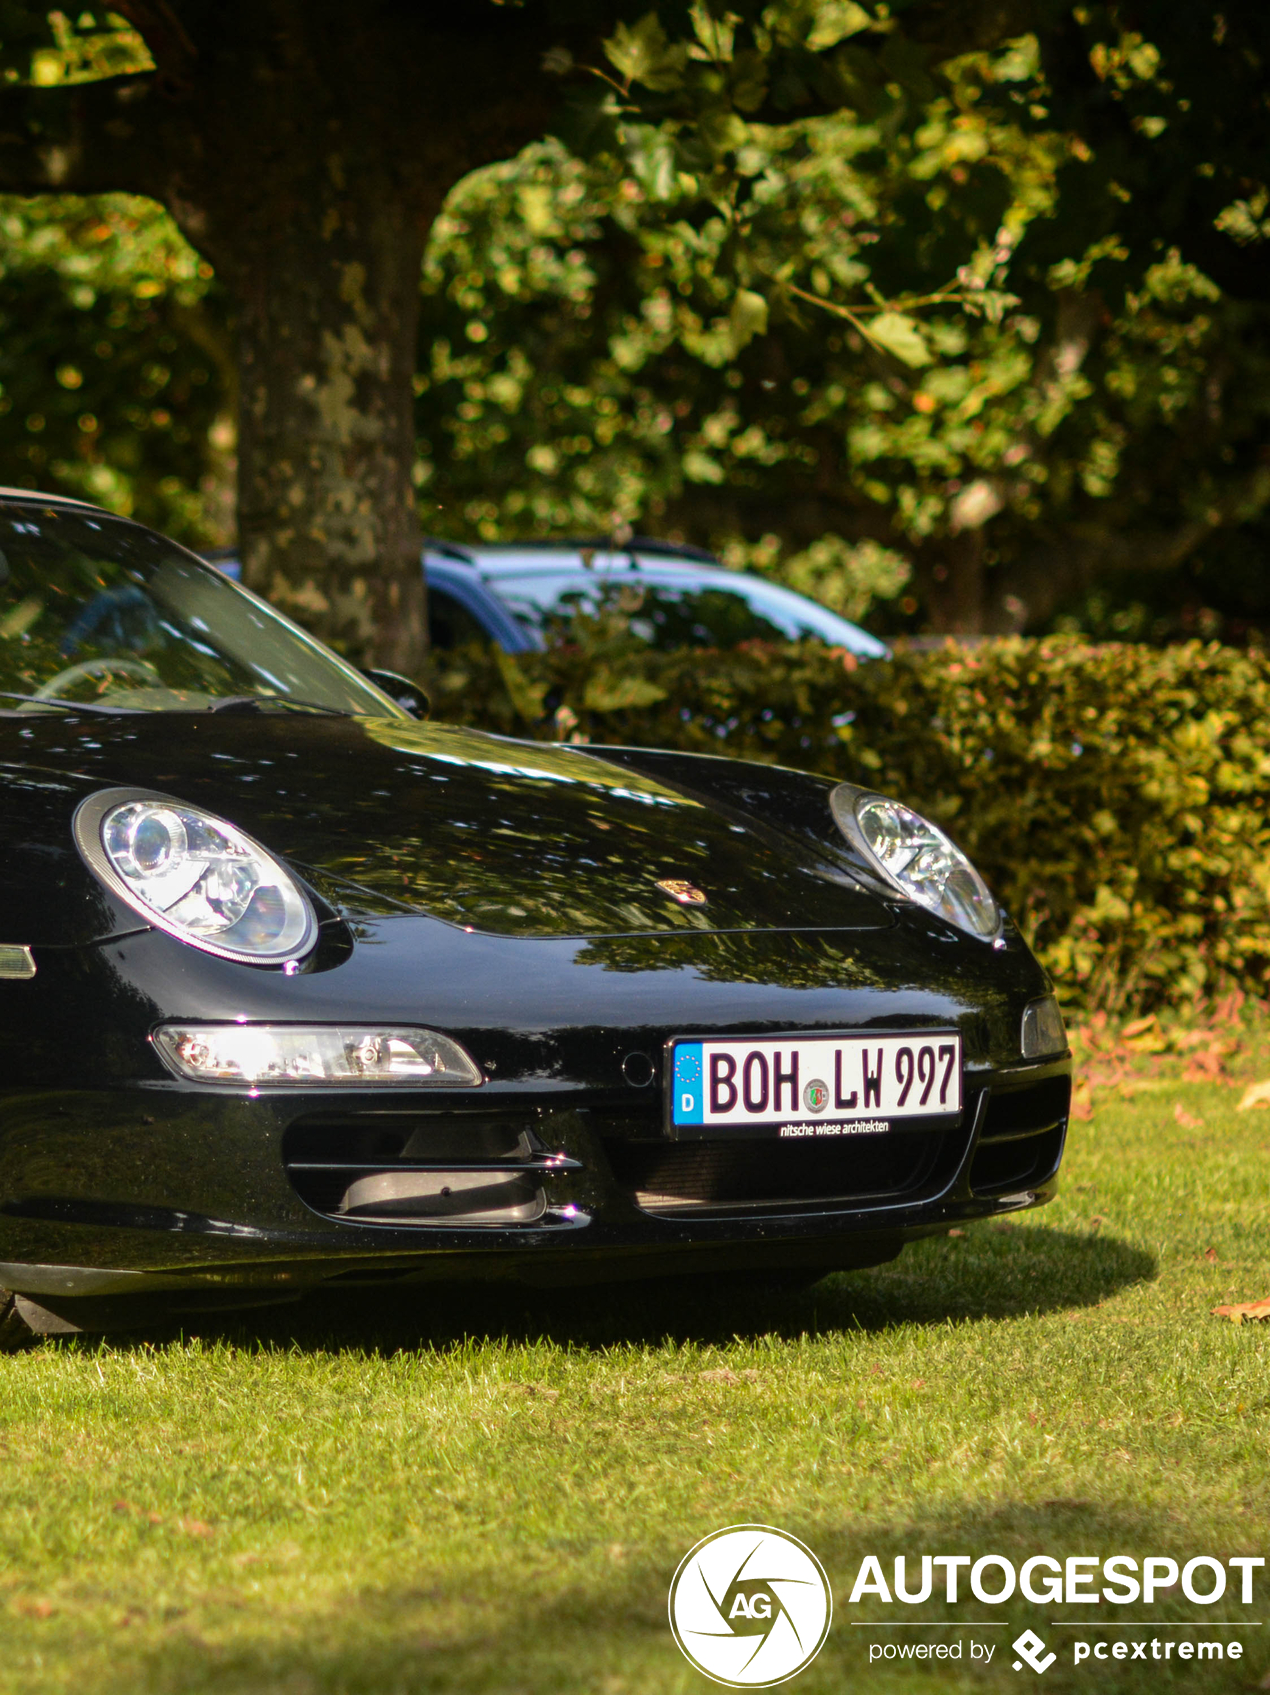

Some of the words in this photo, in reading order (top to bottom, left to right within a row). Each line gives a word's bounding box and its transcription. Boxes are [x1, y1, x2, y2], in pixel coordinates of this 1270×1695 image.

[710, 1051, 799, 1114] BOH
[834, 1047, 884, 1109] LW
[895, 1044, 956, 1107] 997
[682, 1093, 694, 1112] D
[780, 1122, 814, 1137] nitsche
[815, 1122, 841, 1135] wiese
[842, 1119, 889, 1134] architekten
